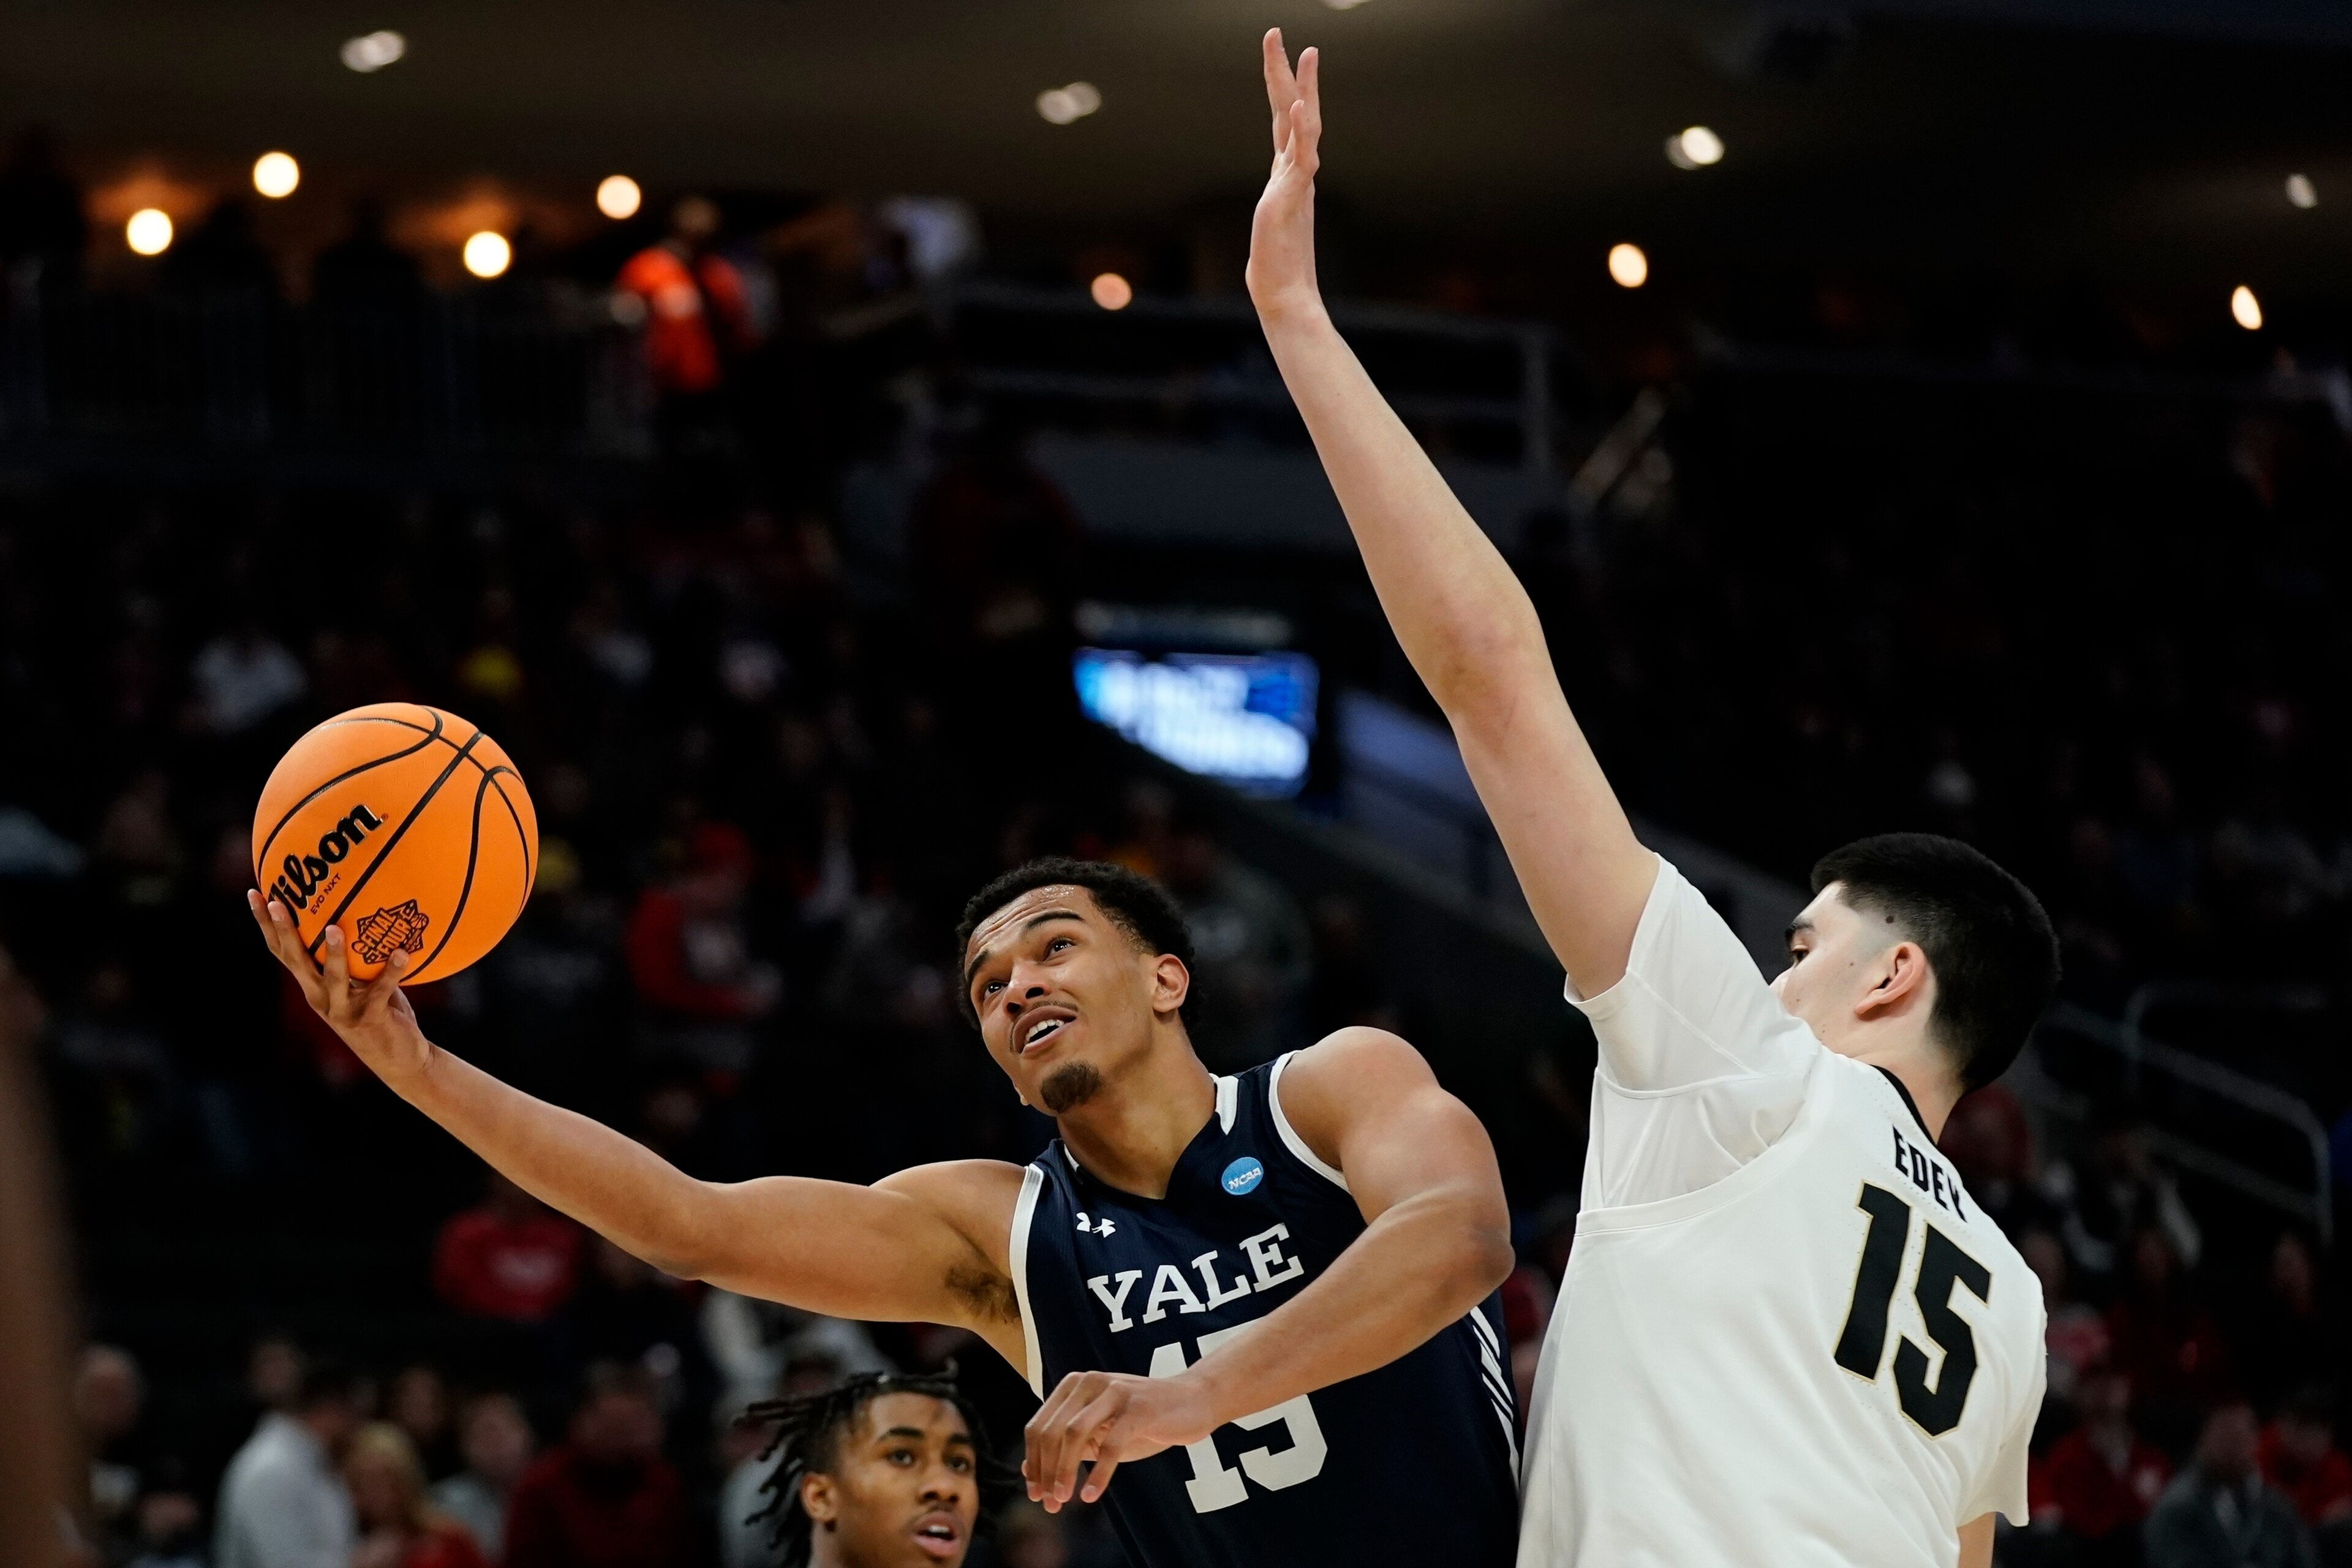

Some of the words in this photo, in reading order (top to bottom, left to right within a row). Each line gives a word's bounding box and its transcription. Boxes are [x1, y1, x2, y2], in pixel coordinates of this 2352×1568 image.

[323, 873, 341, 895] NXT
[361, 910, 396, 948] FINAL
[376, 918, 412, 956] FOUR
[1228, 1167, 1262, 1190] NCAA
[1892, 1125, 1968, 1224] EDEY
[1087, 1223, 1304, 1333] YALE
[1833, 1178, 1992, 1441] 15
[1148, 1317, 1328, 1513] 15
